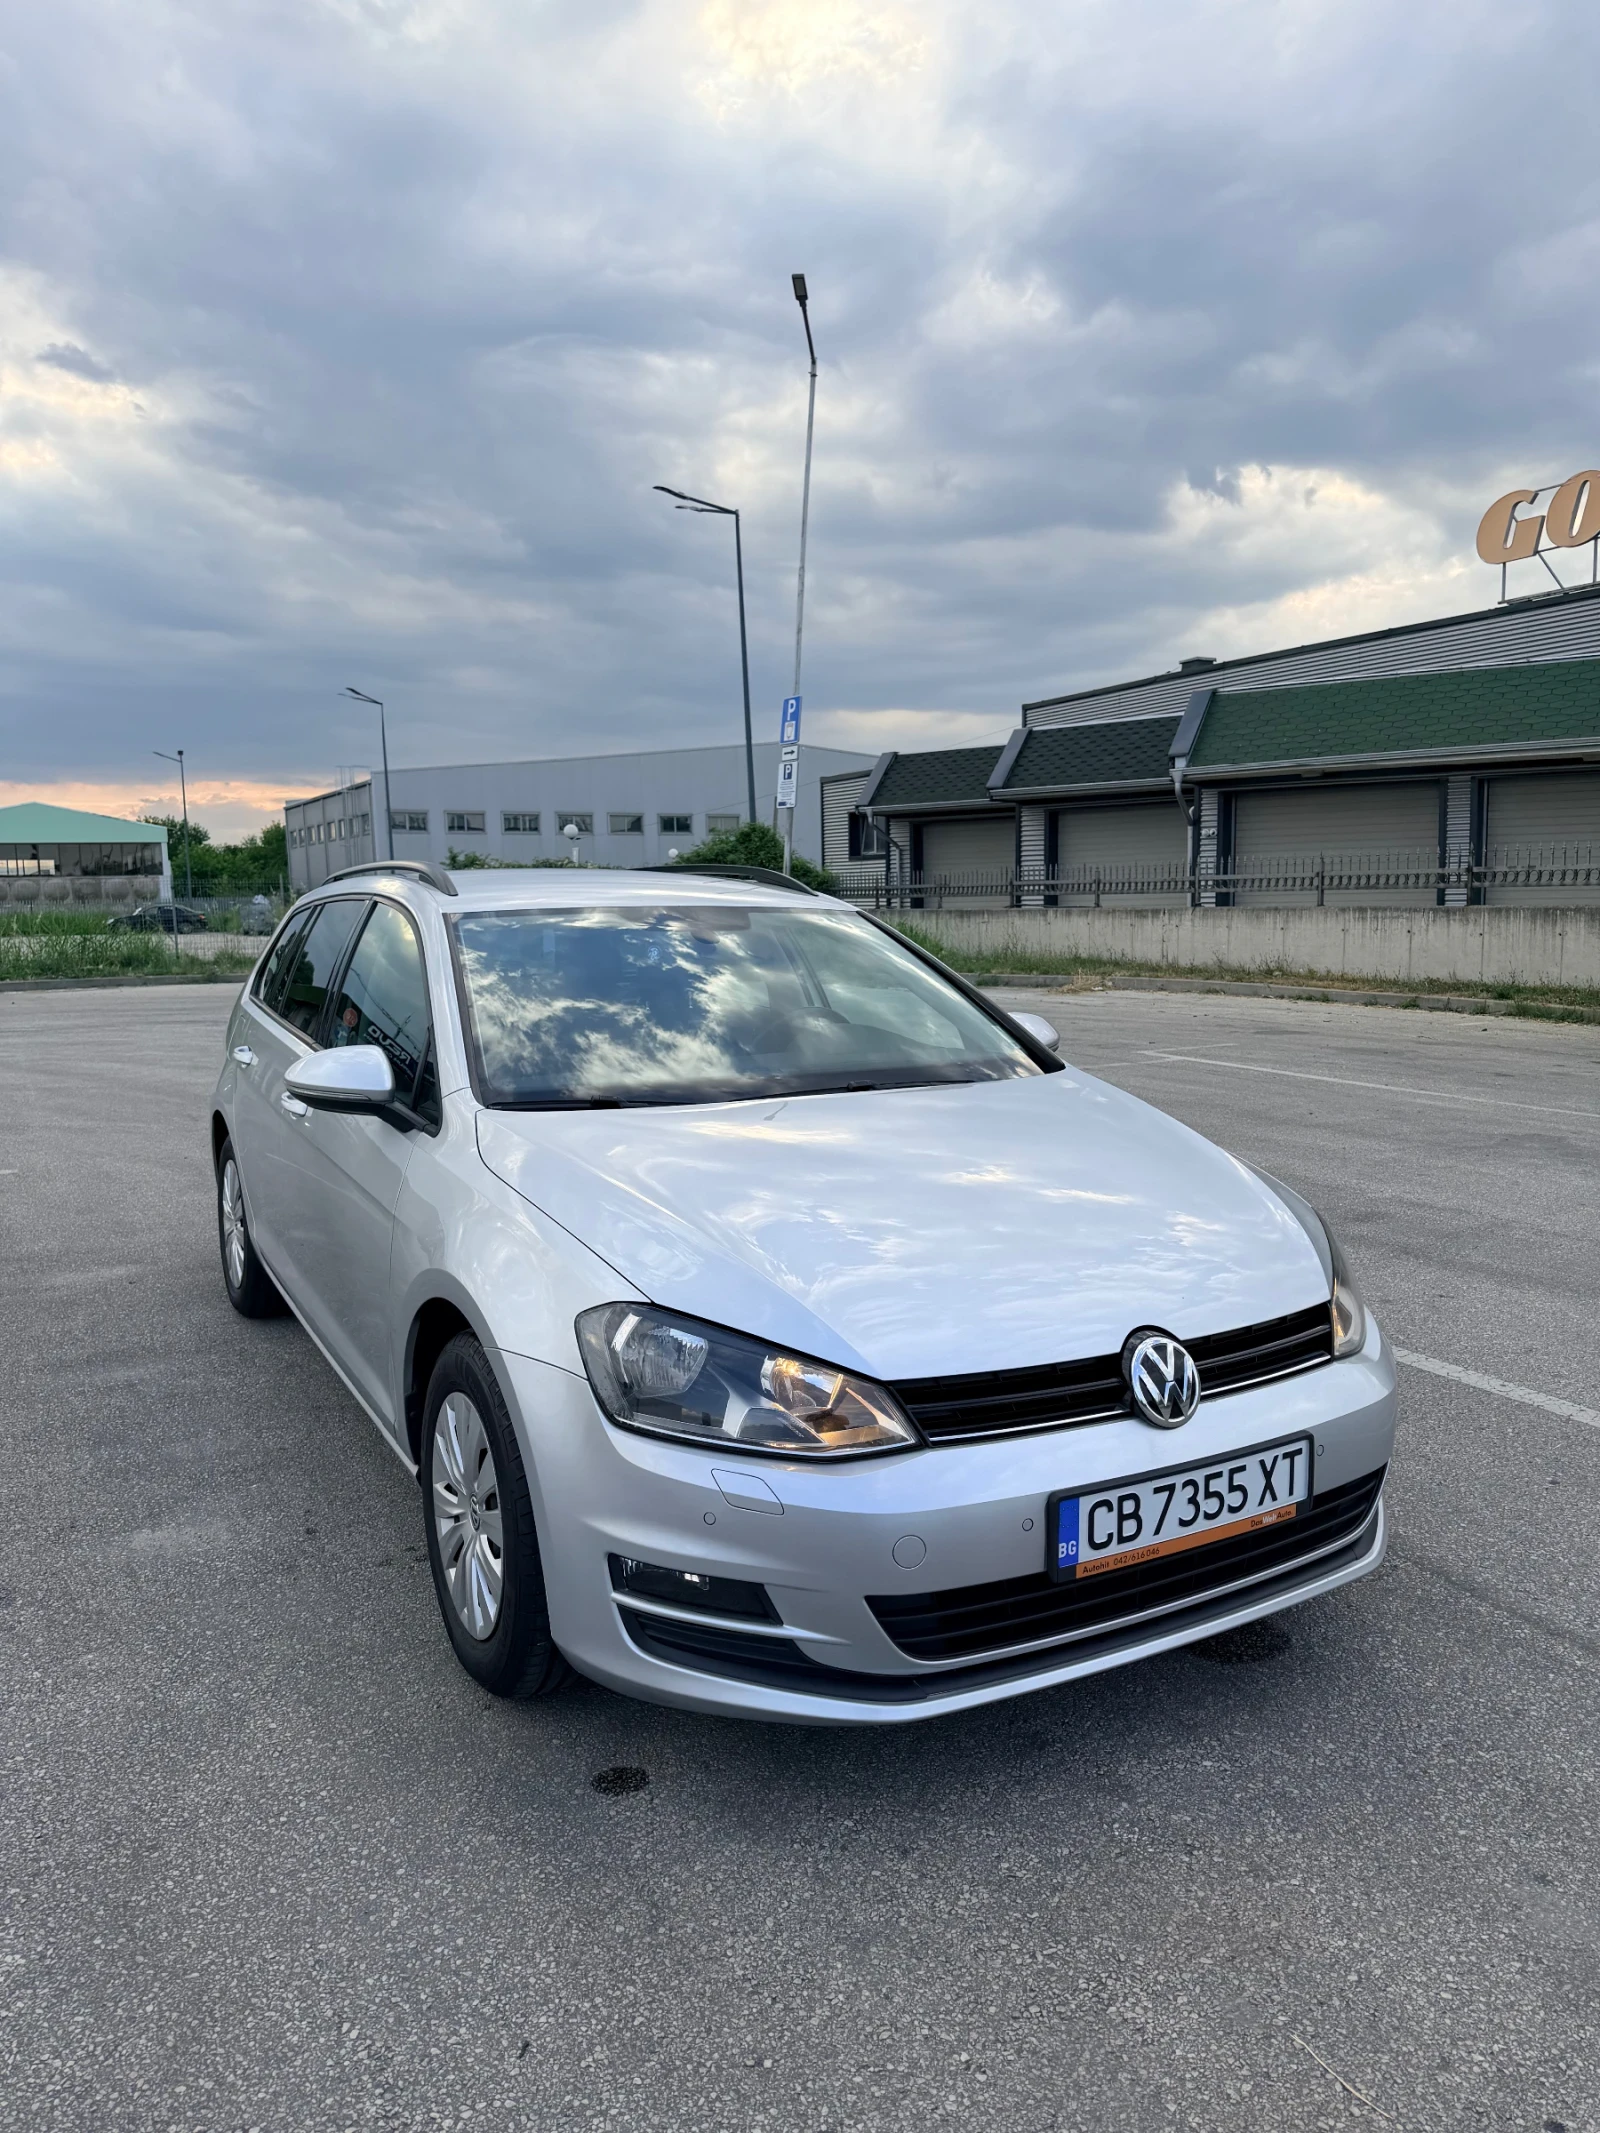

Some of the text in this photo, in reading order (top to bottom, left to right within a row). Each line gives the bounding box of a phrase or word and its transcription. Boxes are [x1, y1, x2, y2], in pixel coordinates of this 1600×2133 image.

[1476, 470, 1600, 564] GO
[787, 699, 796, 720] P
[785, 765, 792, 778] P
[1087, 1447, 1303, 1551] CB 7355 XT
[1058, 1540, 1077, 1559] BG
[1082, 1561, 1110, 1575] Autohit
